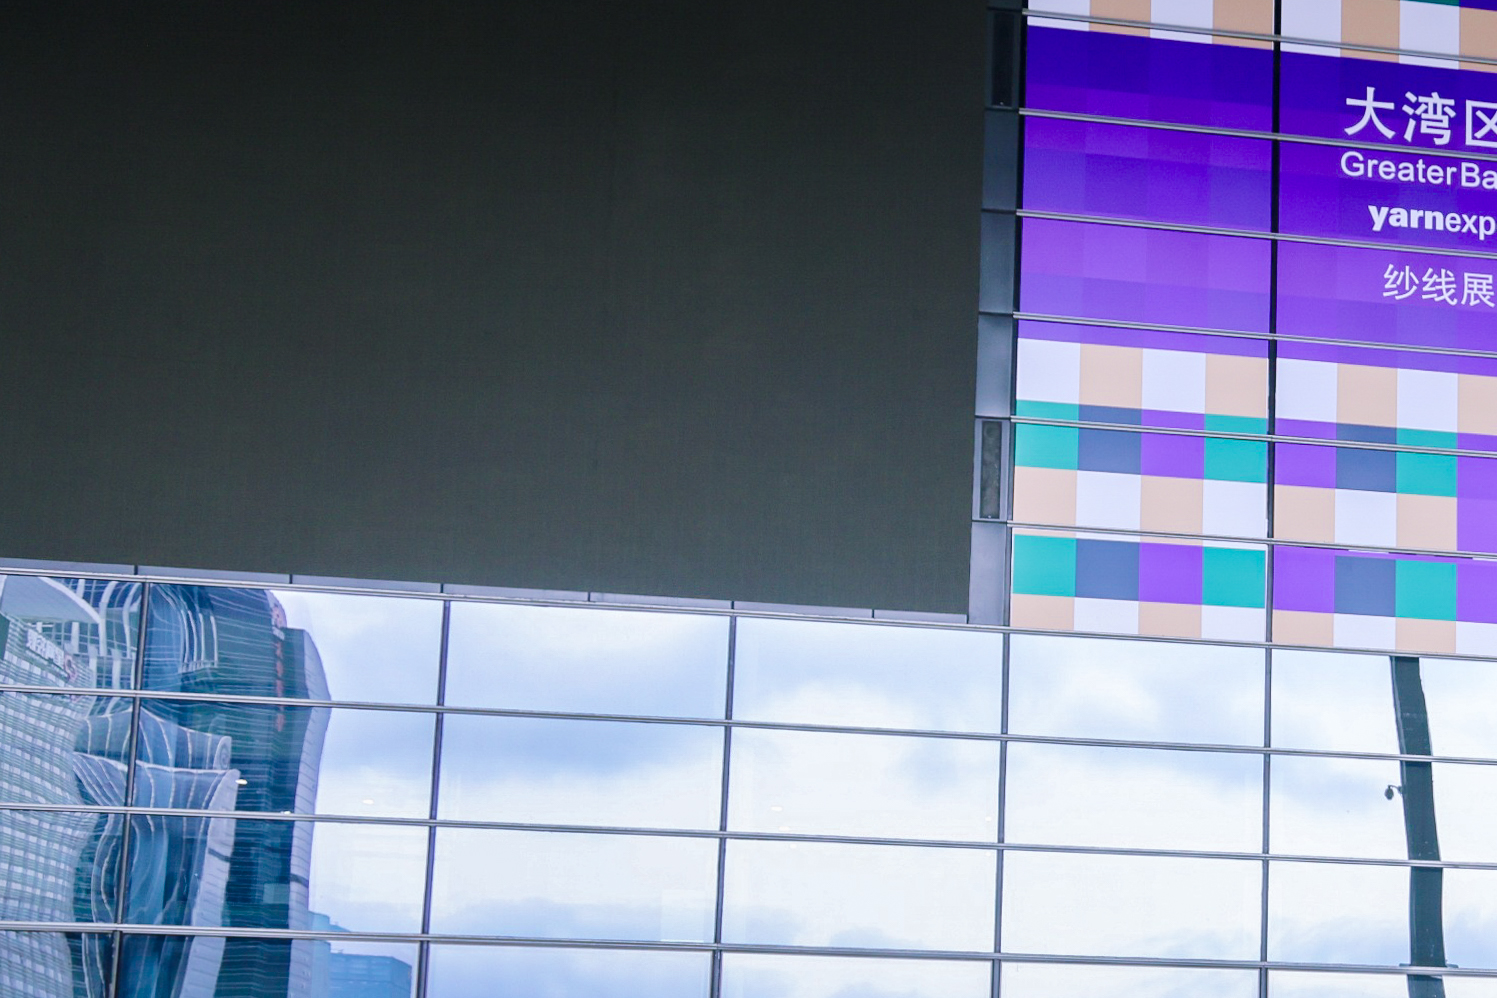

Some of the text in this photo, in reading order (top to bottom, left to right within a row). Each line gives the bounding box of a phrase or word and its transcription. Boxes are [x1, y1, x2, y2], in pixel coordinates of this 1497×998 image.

[1340, 151, 1457, 185] Greater
[1383, 264, 1495, 307] 纱线展
